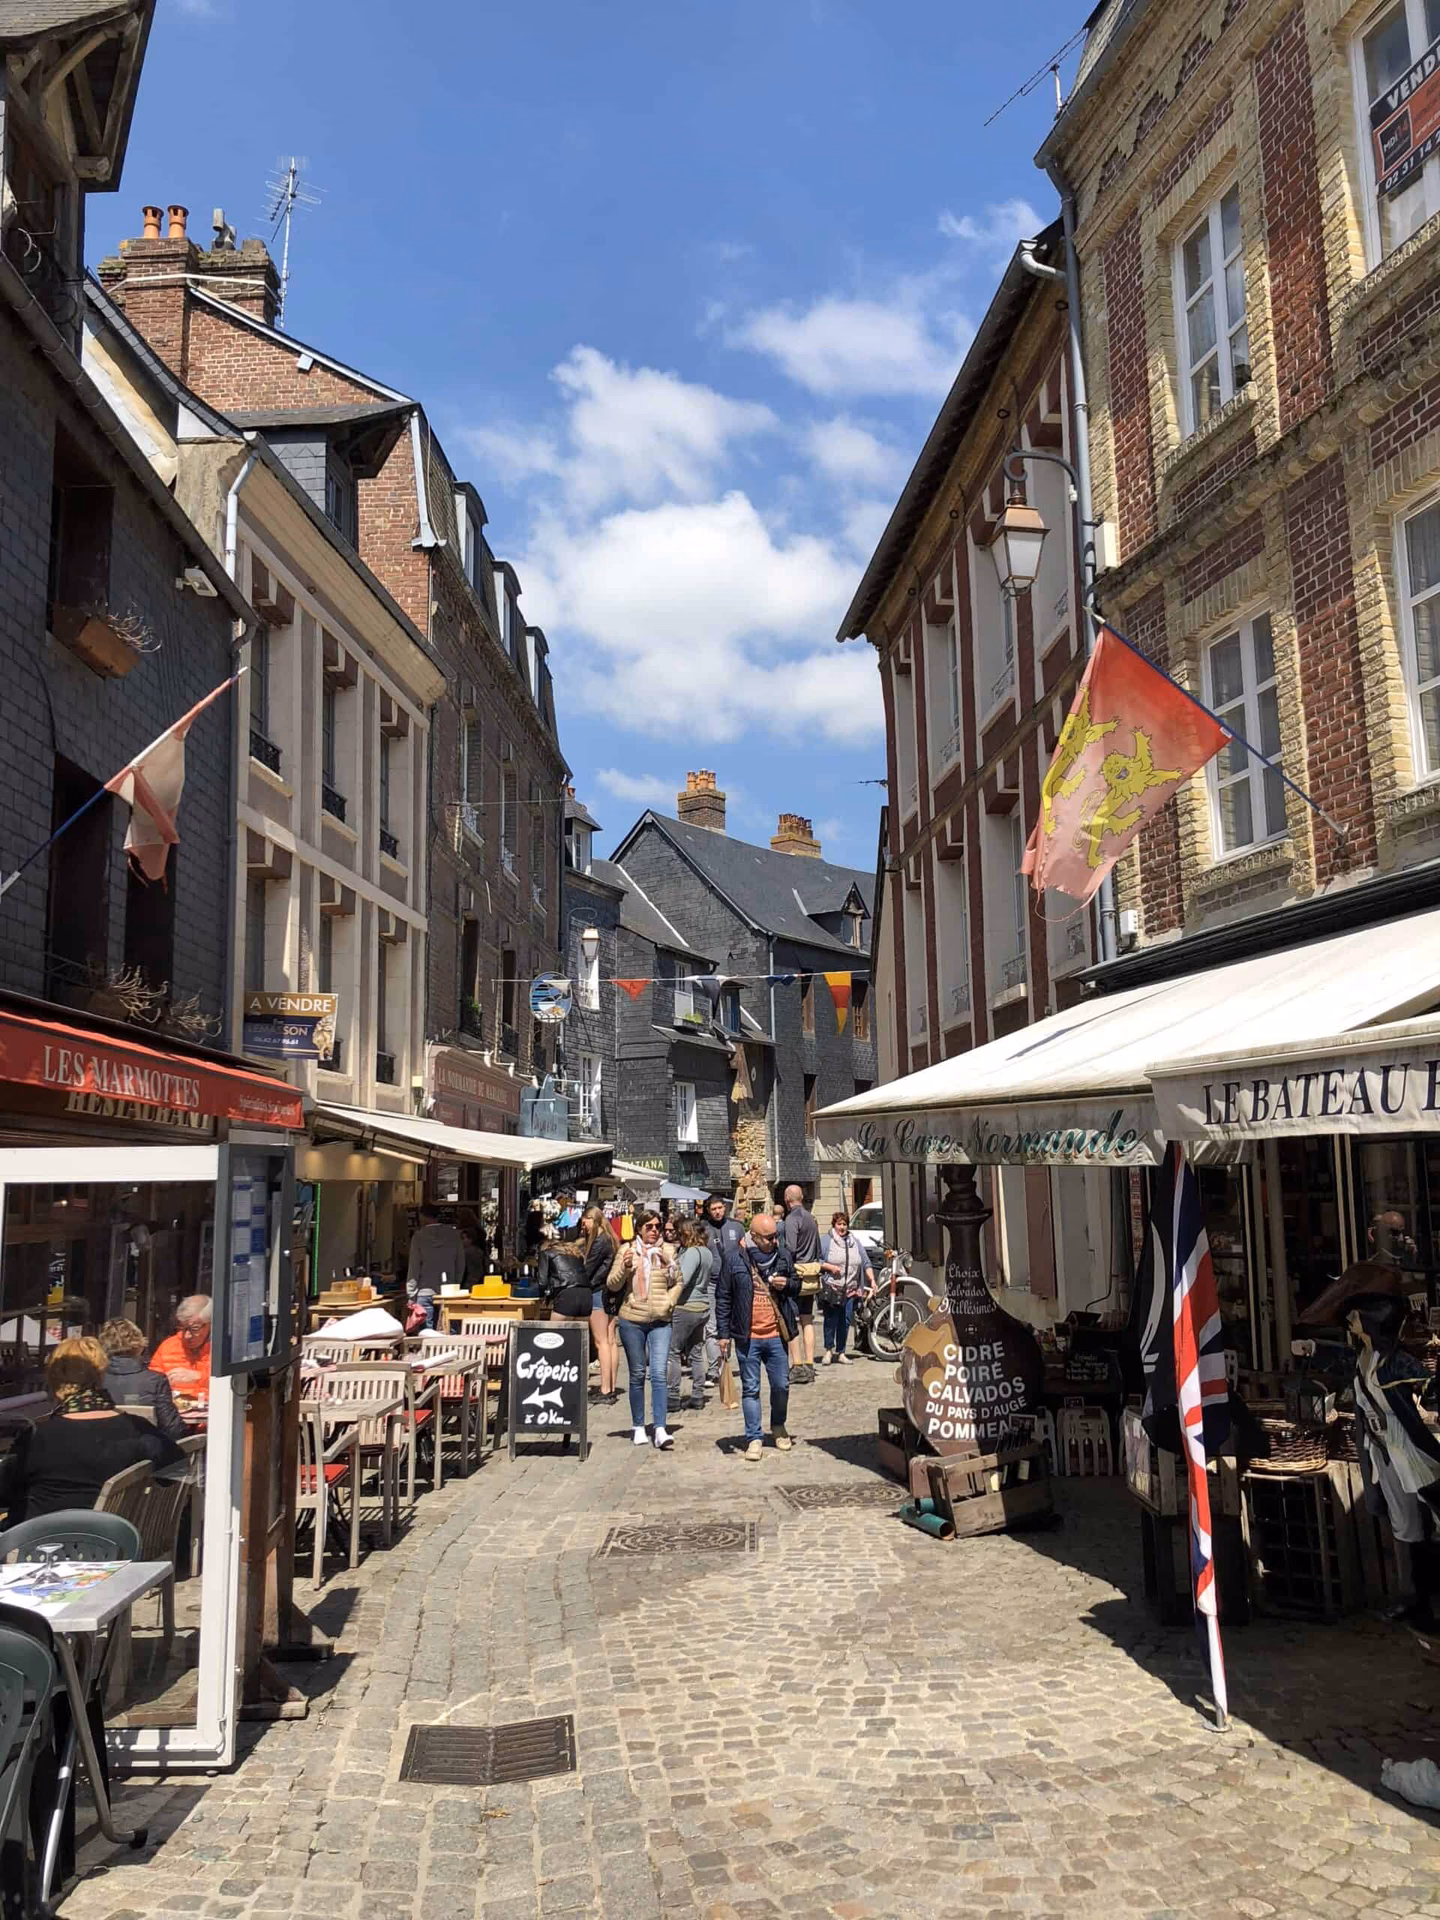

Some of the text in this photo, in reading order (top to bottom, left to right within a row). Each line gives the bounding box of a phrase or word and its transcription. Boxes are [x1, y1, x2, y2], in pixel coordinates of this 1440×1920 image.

[1386, 45, 1440, 111] VEND
[1385, 170, 1399, 190] 02
[1402, 156, 1414, 175] 31
[1419, 138, 1432, 158] 14
[250, 997, 333, 1012] A VENDRE
[43, 1045, 200, 1108] LES MARMOTTES
[1203, 1081, 1242, 1125] LE
[1249, 1063, 1411, 1123] BATEAU
[858, 1109, 1148, 1156] La Cave Normande
[948, 1262, 980, 1278] Choix
[947, 1281, 986, 1297] Calvados
[943, 1341, 1005, 1362] CIDRE
[516, 1352, 579, 1386] Crêperie
[944, 1360, 1004, 1384] POIRÉ
[928, 1376, 1026, 1404] CALVADOS
[925, 1396, 1027, 1419] DU PAYS D'AUGE
[927, 1419, 1011, 1439] POMMEA
